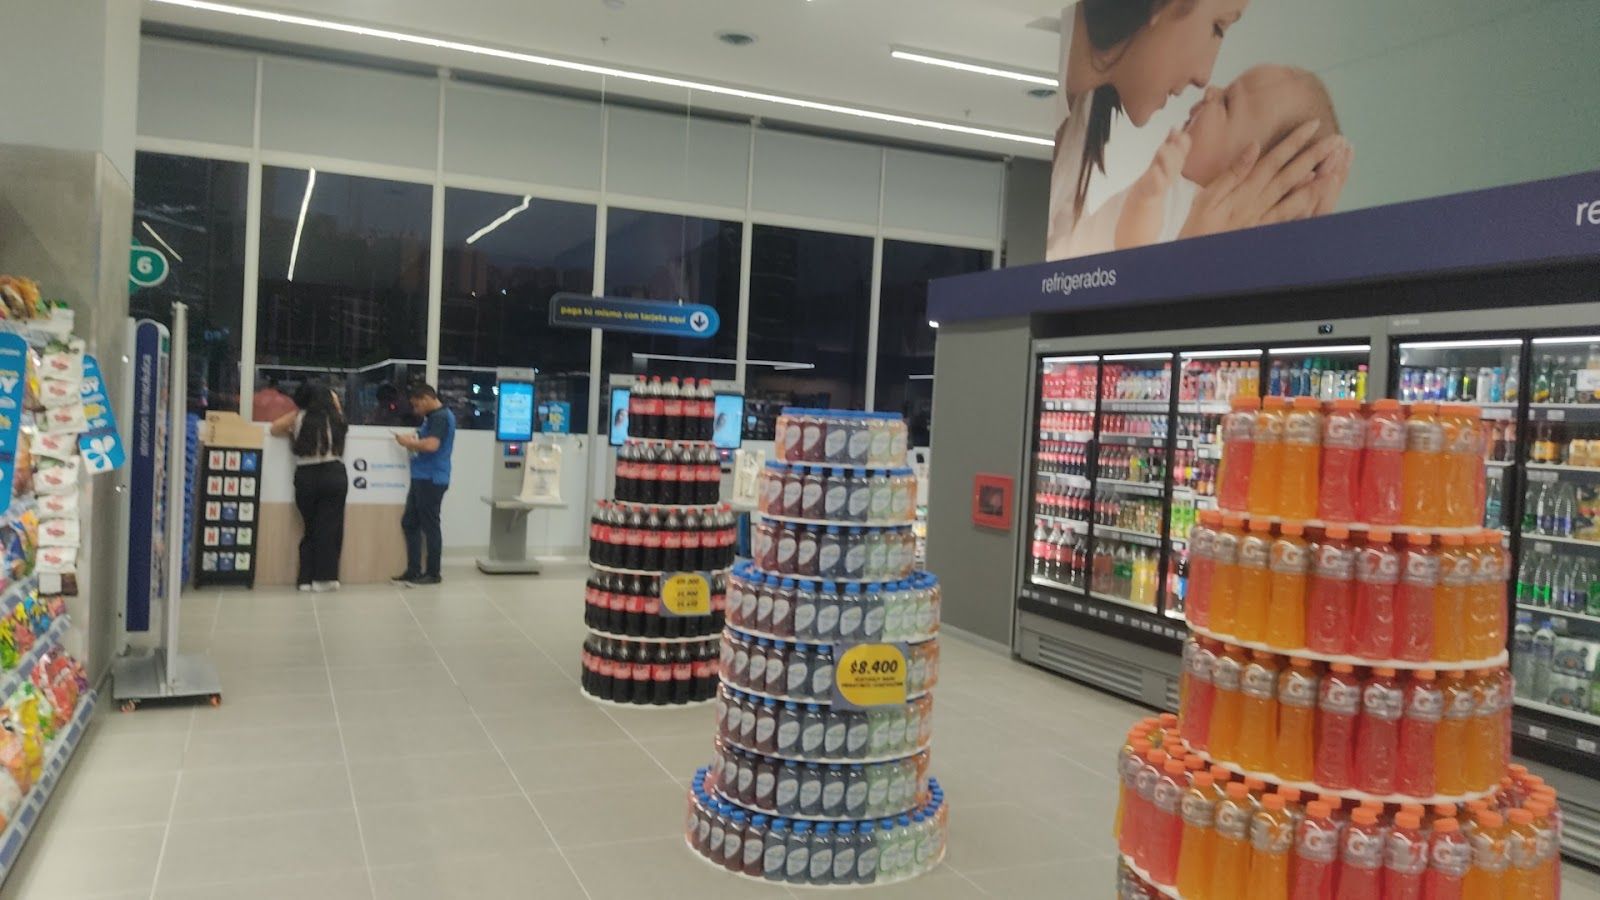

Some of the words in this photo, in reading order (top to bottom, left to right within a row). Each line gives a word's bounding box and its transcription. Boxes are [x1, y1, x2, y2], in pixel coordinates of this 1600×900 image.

[1576, 200, 1600, 226] re
[136, 256, 153, 274] 6
[1041, 267, 1117, 295] refrigerados
[560, 306, 582, 316] paga
[595, 308, 622, 319] mismo
[624, 311, 639, 320] con
[640, 312, 667, 322] tarjeta
[850, 660, 898, 674] $8.400
